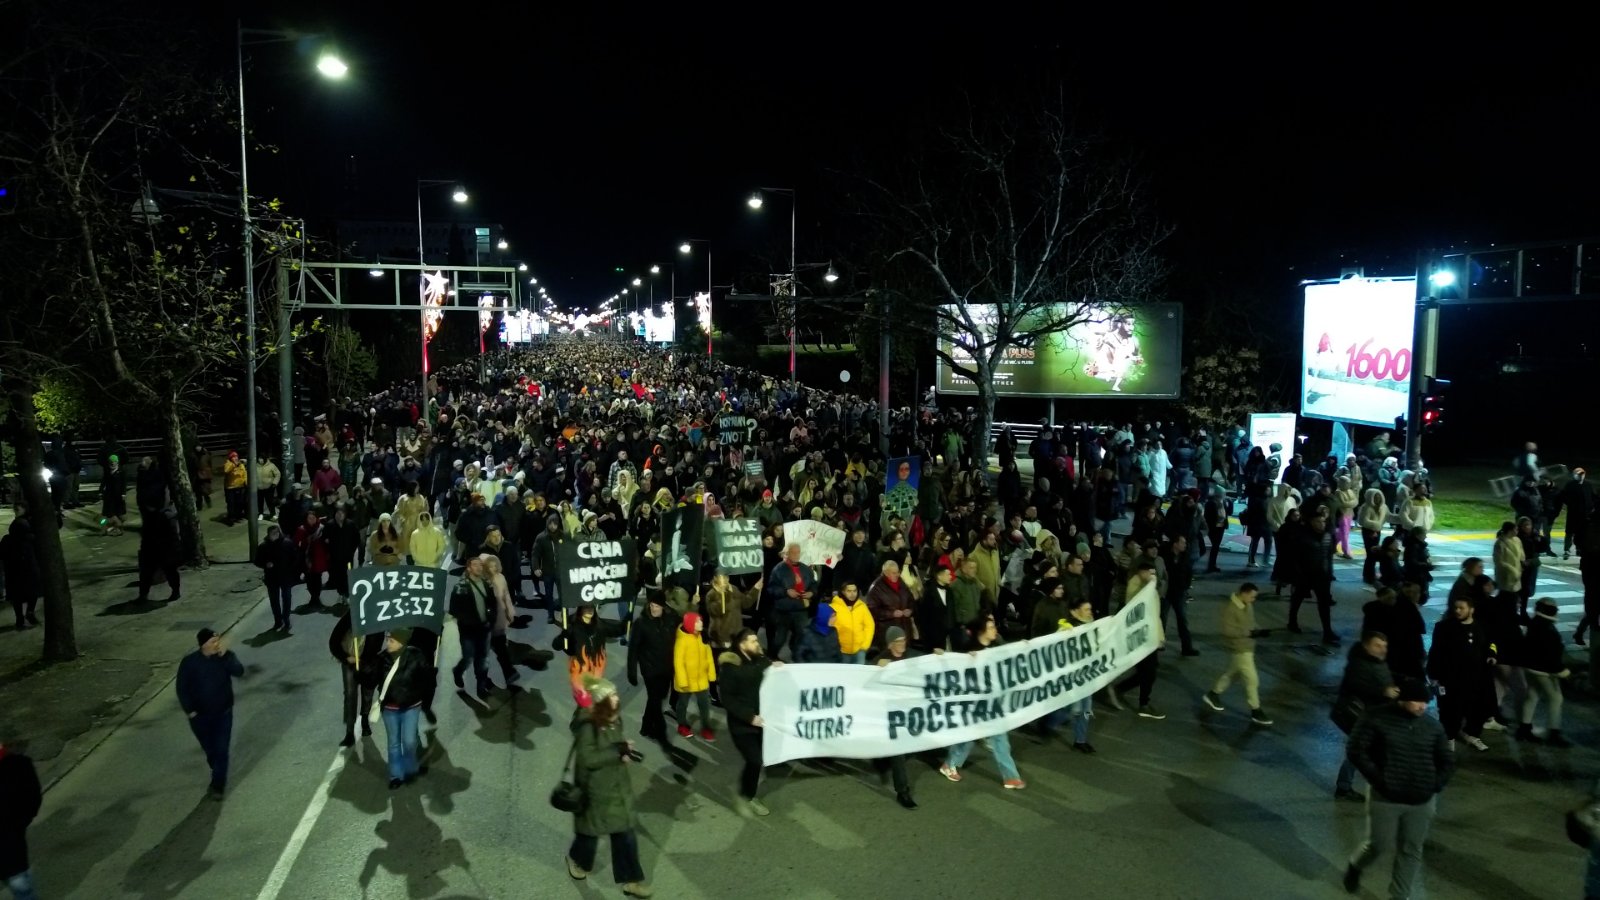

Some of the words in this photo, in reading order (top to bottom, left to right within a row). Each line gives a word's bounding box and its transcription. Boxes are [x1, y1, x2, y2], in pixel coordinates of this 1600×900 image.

[1346, 337, 1412, 381] 1600
[746, 418, 758, 443] ?
[577, 541, 623, 559] CRNA
[373, 571, 434, 590] 17:26
[376, 597, 435, 621] 23:32
[923, 664, 992, 699] KRAJ
[997, 627, 1100, 691] IZGOVORA!
[800, 686, 845, 712] KAMO
[888, 694, 1006, 739] POČETAK
